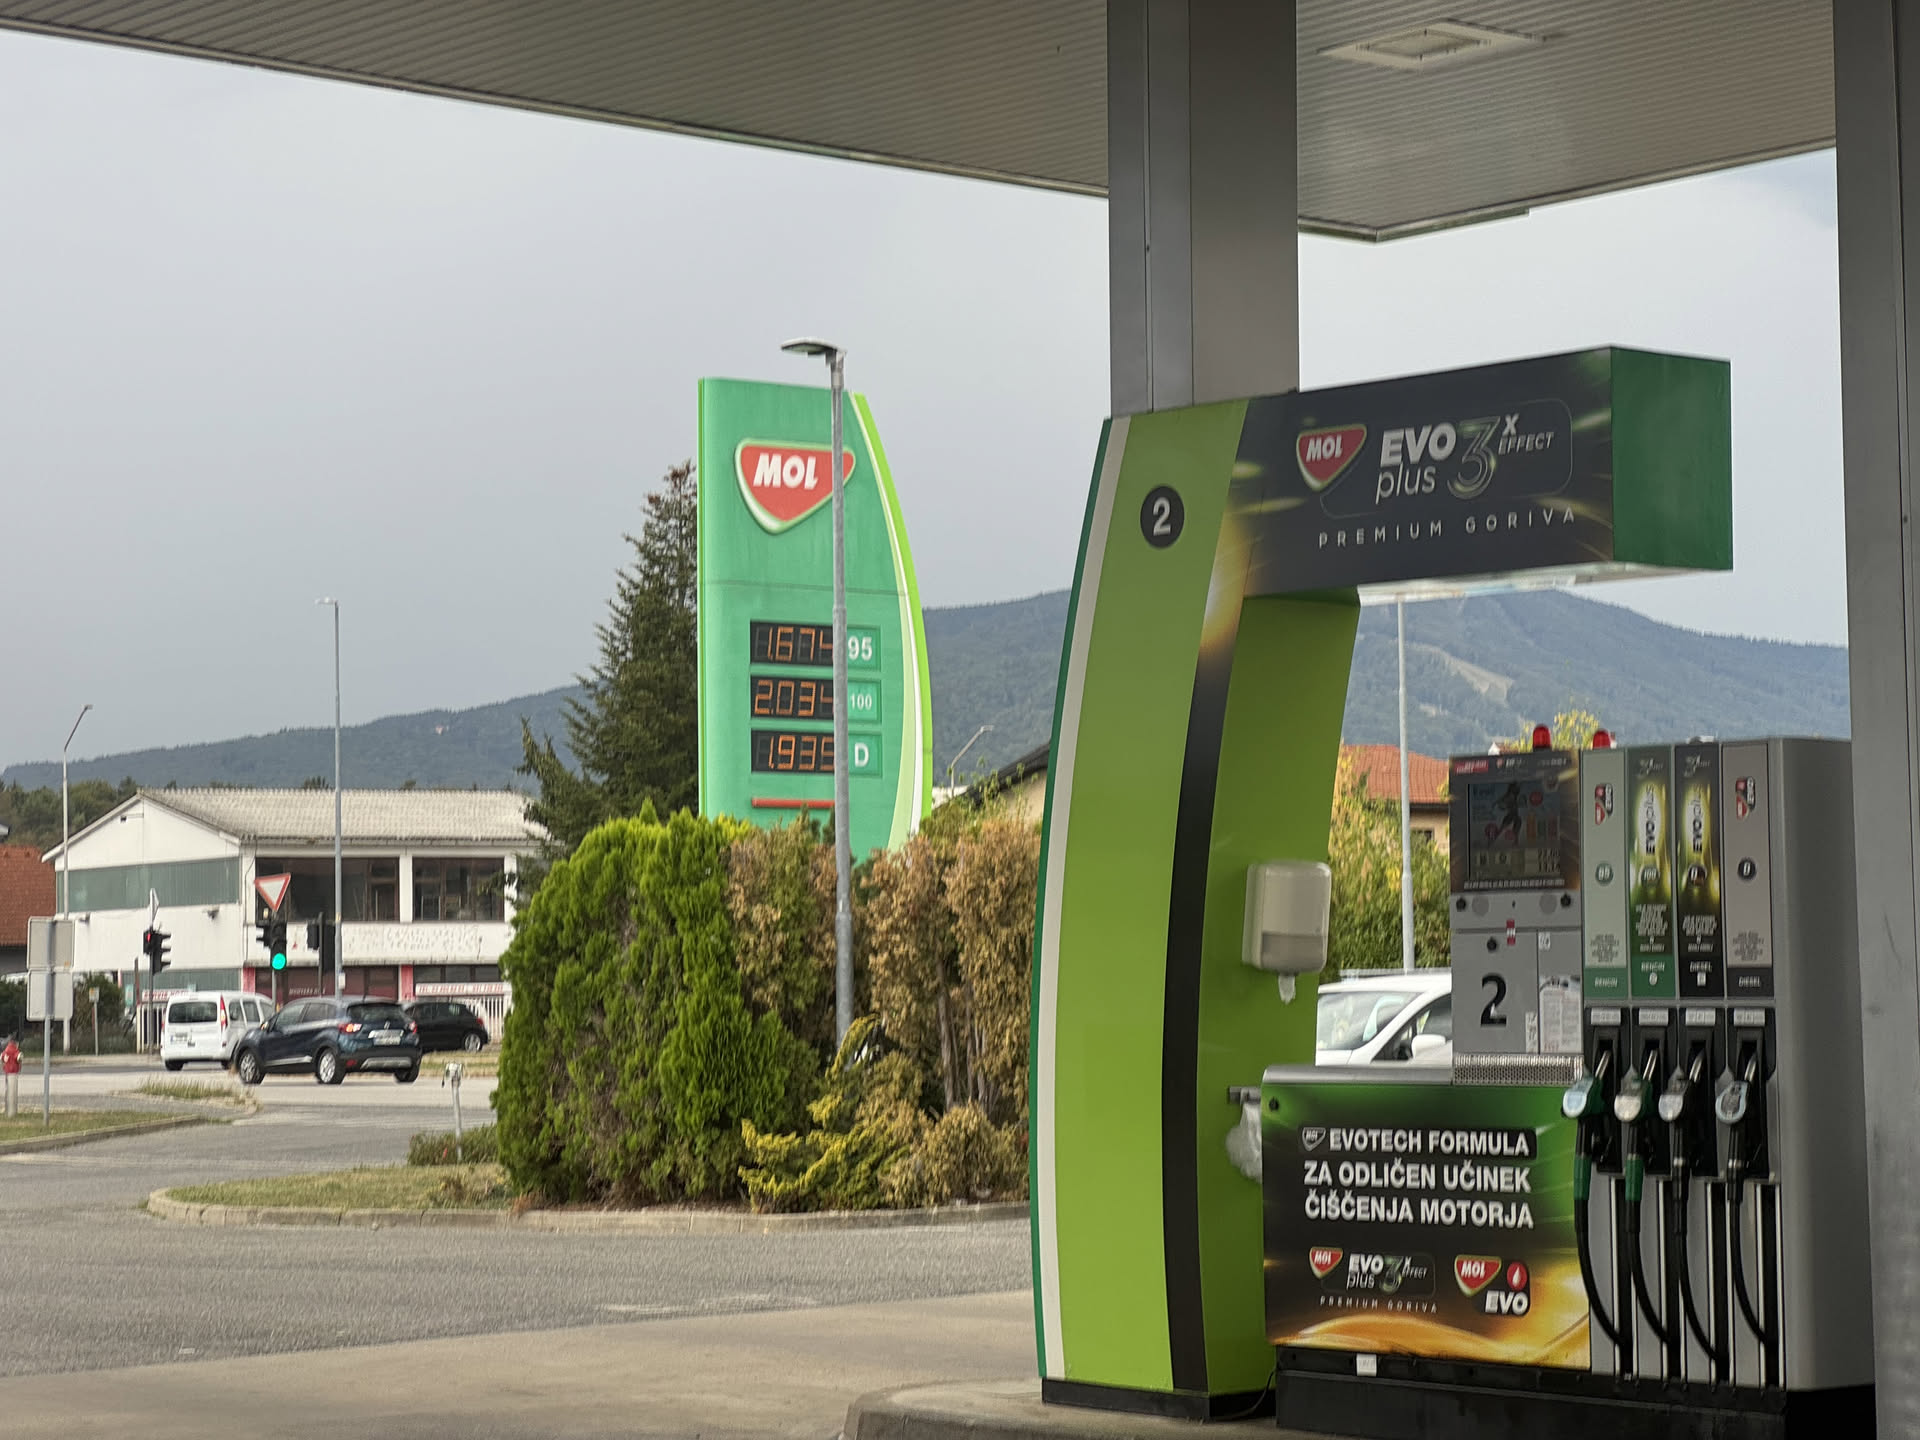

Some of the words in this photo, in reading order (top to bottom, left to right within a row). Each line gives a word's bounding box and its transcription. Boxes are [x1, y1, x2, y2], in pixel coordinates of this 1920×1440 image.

[1306, 434, 1343, 462] MOL
[1380, 422, 1457, 467] EVO
[1499, 431, 1555, 455] EFFECT
[752, 453, 819, 489] MOL
[1375, 464, 1436, 504] plus
[1152, 497, 1173, 536] 2
[1318, 519, 1443, 548] PREMIUM
[1466, 506, 1576, 535] GORIVA
[848, 636, 873, 661] 95
[850, 693, 873, 711] 100
[854, 742, 870, 768] D
[1480, 975, 1507, 1026] 2
[1329, 1128, 1421, 1153] EVOTECH
[1428, 1130, 1530, 1156] FORMULA
[1303, 1160, 1333, 1185] ZA
[1338, 1158, 1436, 1190] ODLIČEN
[1443, 1160, 1532, 1193] UČINEK
[1304, 1189, 1413, 1224] ČIŠČENJA
[1420, 1199, 1534, 1229] MOTORJA
[1348, 1254, 1384, 1275] EVO
[1460, 1259, 1487, 1279] MOL
[1346, 1269, 1375, 1290] plus
[1484, 1290, 1529, 1315] EVO
